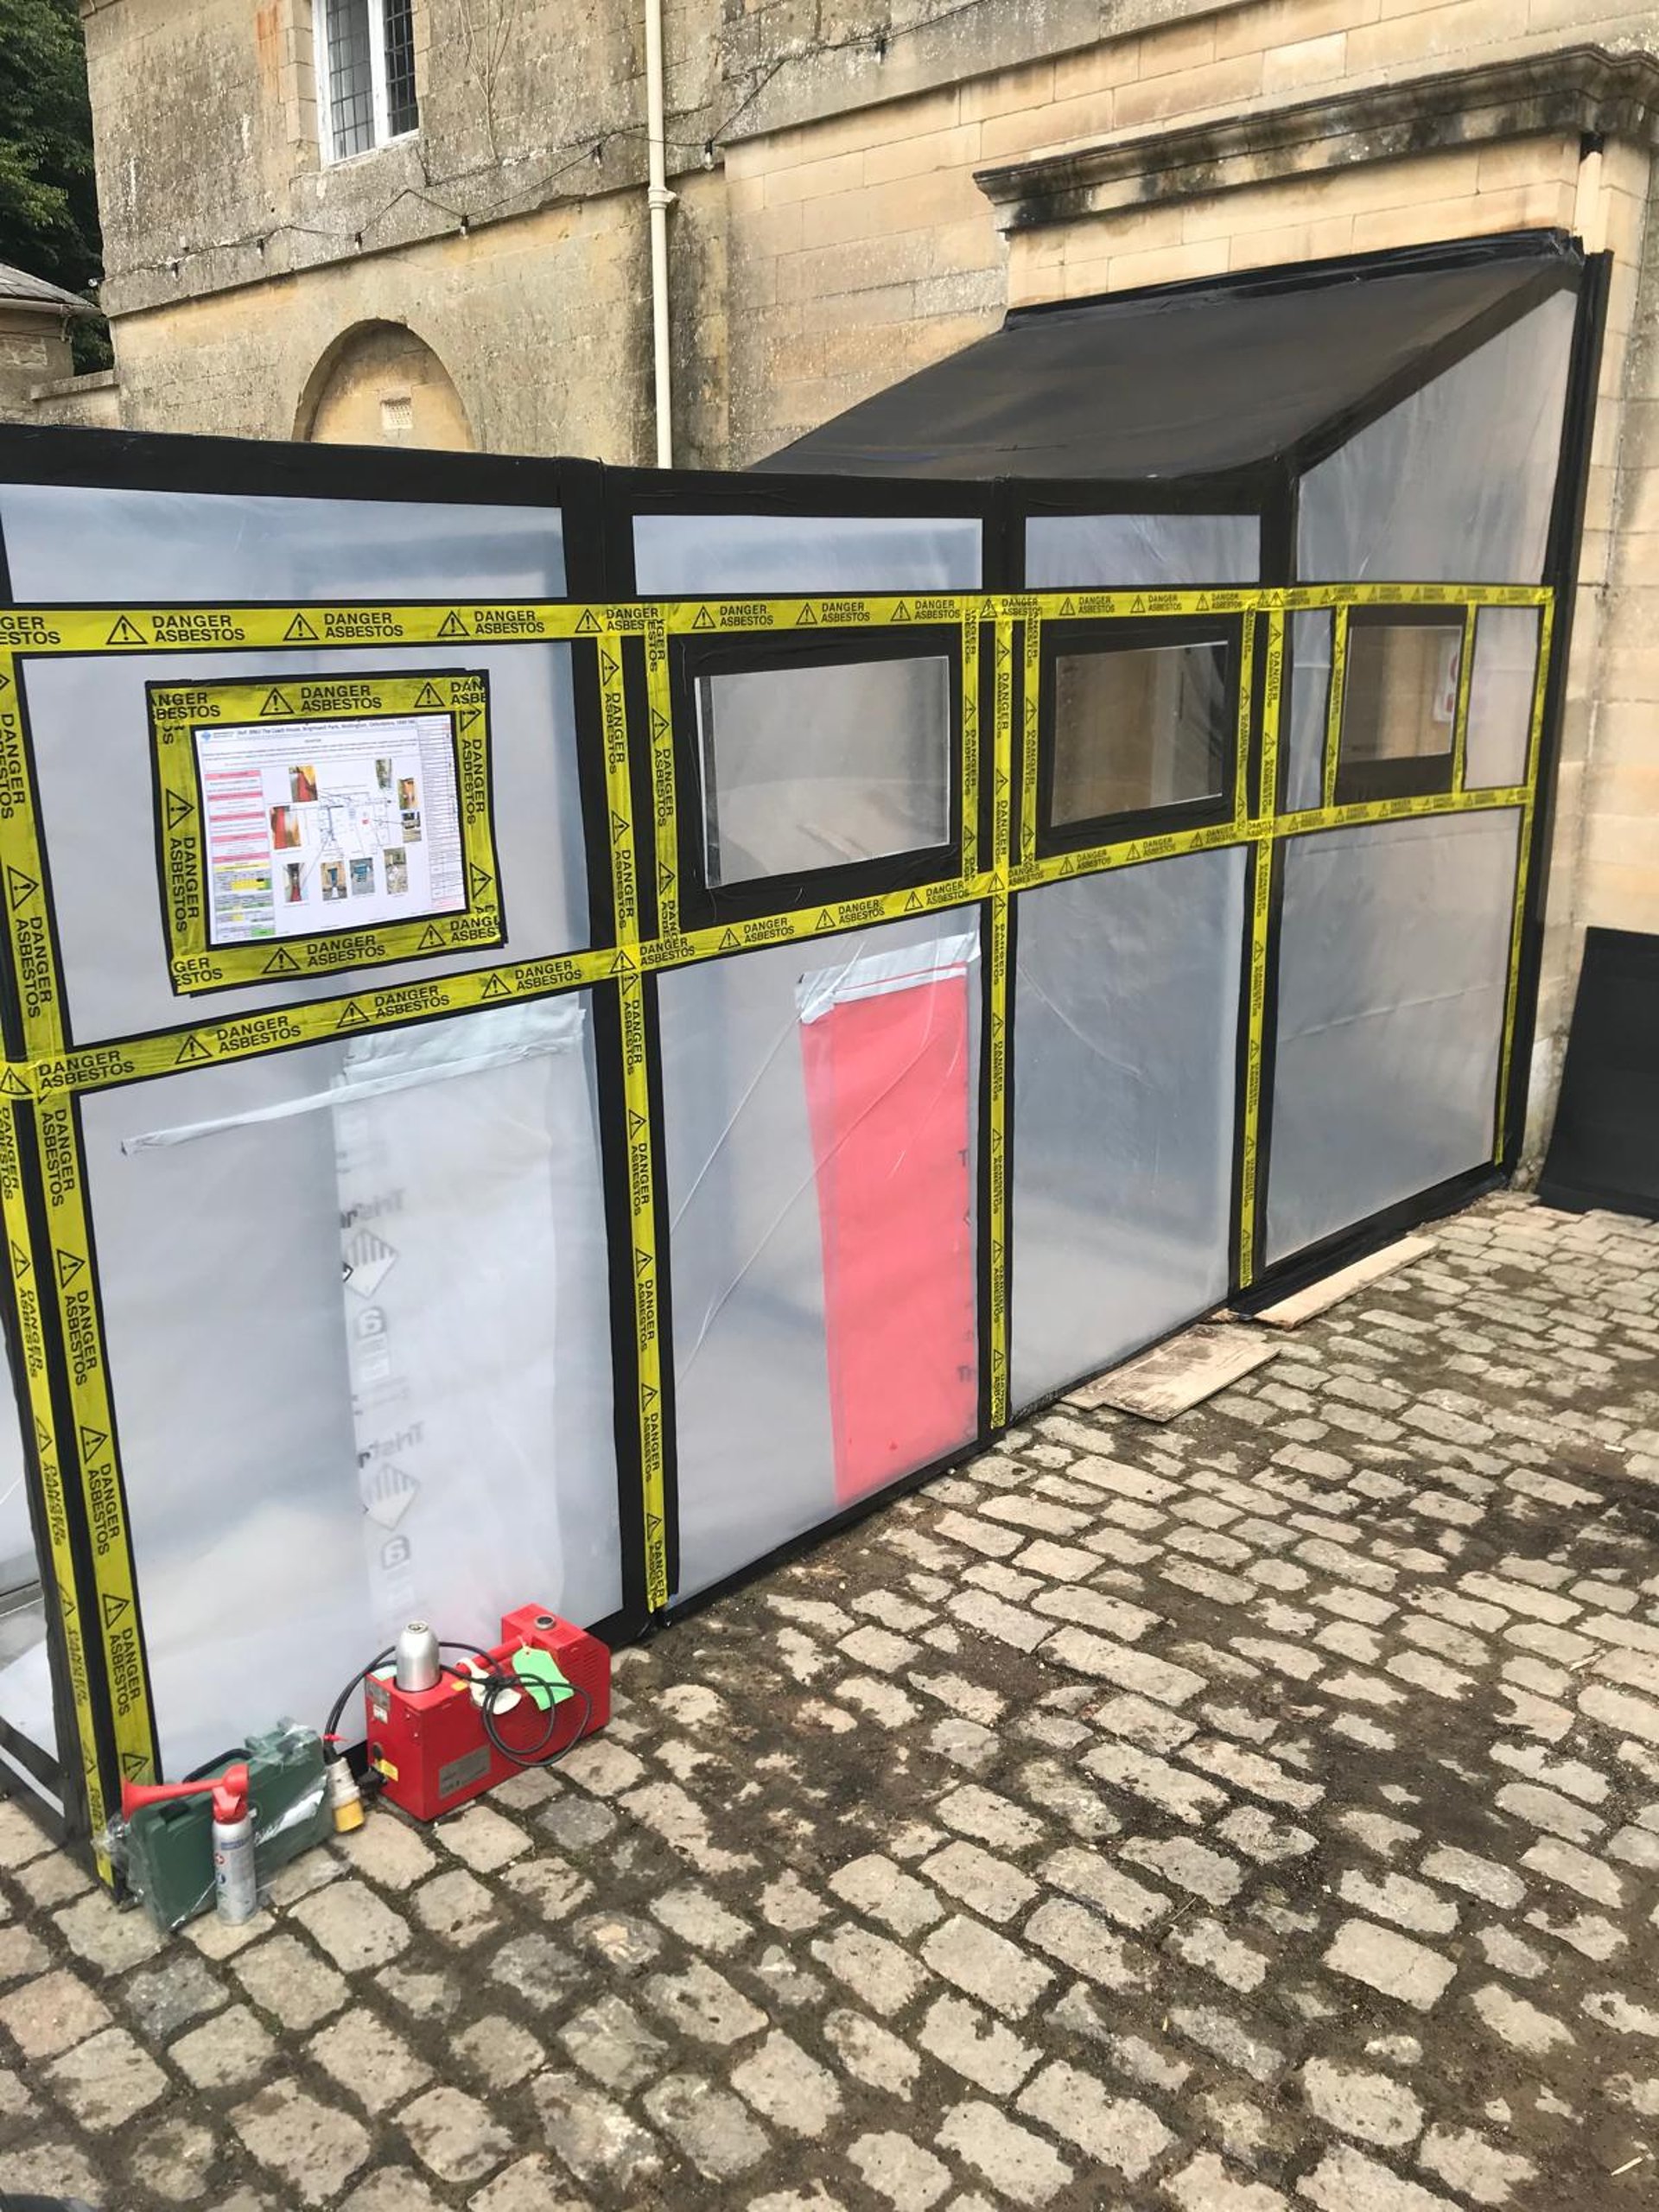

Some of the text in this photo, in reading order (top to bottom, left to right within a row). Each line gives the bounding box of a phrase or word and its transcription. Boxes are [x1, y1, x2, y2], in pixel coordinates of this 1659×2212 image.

[607, 607, 658, 619] DANGER
[720, 605, 766, 616] DANGER
[822, 602, 865, 613] DANGER
[915, 600, 955, 610] DANGER
[1001, 598, 1039, 607] DANGER
[0, 616, 45, 630] GER
[153, 614, 232, 628] DANGER
[324, 612, 392, 626] DANGER
[475, 610, 536, 622] DANGER
[720, 615, 774, 626] ASBESTOS
[821, 612, 870, 622] ASBESTOS
[914, 609, 961, 620] ASBESTOS
[155, 629, 245, 642] ASBESTOS
[325, 625, 404, 638] ASBESTOS
[474, 621, 545, 635] ASBESTOS
[607, 620, 645, 632] ASBES
[0, 631, 60, 645] ESTOS
[647, 620, 658, 673] ESTOS
[656, 619, 666, 661] GER
[301, 684, 371, 698] DANGER
[451, 681, 486, 693] DAN
[301, 696, 383, 712] ASBESTOS
[451, 692, 486, 705] ASBE
[612, 692, 626, 763] DANGER
[2, 714, 26, 804] DANGER
[0, 741, 14, 819] ESTOS
[461, 739, 476, 824] ASBESTOS
[472, 739, 486, 813] DANGER
[662, 748, 674, 817] DANGER
[654, 749, 667, 828] ASBESTOS
[169, 837, 188, 933] ASBESTOS
[183, 836, 200, 919] DANGER
[621, 849, 635, 918] DANGER
[925, 879, 964, 898] DANGER
[838, 899, 880, 914] DANGER
[838, 907, 886, 925] ASBESTOS
[449, 918, 499, 932] DANG
[451, 927, 497, 943] ASBES
[743, 917, 788, 934] DANGER
[745, 926, 795, 944] ASBESTOS
[307, 934, 376, 955] DANGER
[639, 937, 689, 956] DANGER
[29, 916, 53, 1003] DANGER
[175, 957, 211, 973] GER
[308, 944, 386, 967] ASBESTOS
[640, 945, 696, 966] ASBESTOS
[16, 918, 41, 1019] ASBESTOS
[175, 969, 223, 987] ESTOS
[515, 960, 573, 980] DANGER
[517, 969, 582, 991] ASBESTOS
[374, 985, 439, 1007] DANGER
[376, 995, 450, 1019] ASBESTOS
[216, 1015, 289, 1040] DANGER
[632, 999, 643, 1064] DANGER
[218, 1025, 302, 1054] ASBESTOS
[39, 1050, 121, 1077] DANGER
[41, 1061, 136, 1090] ASBESTOS
[41, 1112, 65, 1207] ASBESTOS
[54, 1109, 75, 1192] DANGER
[638, 1142, 650, 1205] DANGER
[645, 1280, 655, 1341] DANGER
[76, 1290, 98, 1370] DANGER
[65, 1295, 87, 1387] ASBESTOS
[650, 1412, 661, 1471] DANGER
[100, 1462, 121, 1538] DANGER
[88, 1469, 111, 1556] ASBESTOS
[121, 1627, 142, 1700] DANGER
[109, 1634, 130, 1717] ASBESTOS
